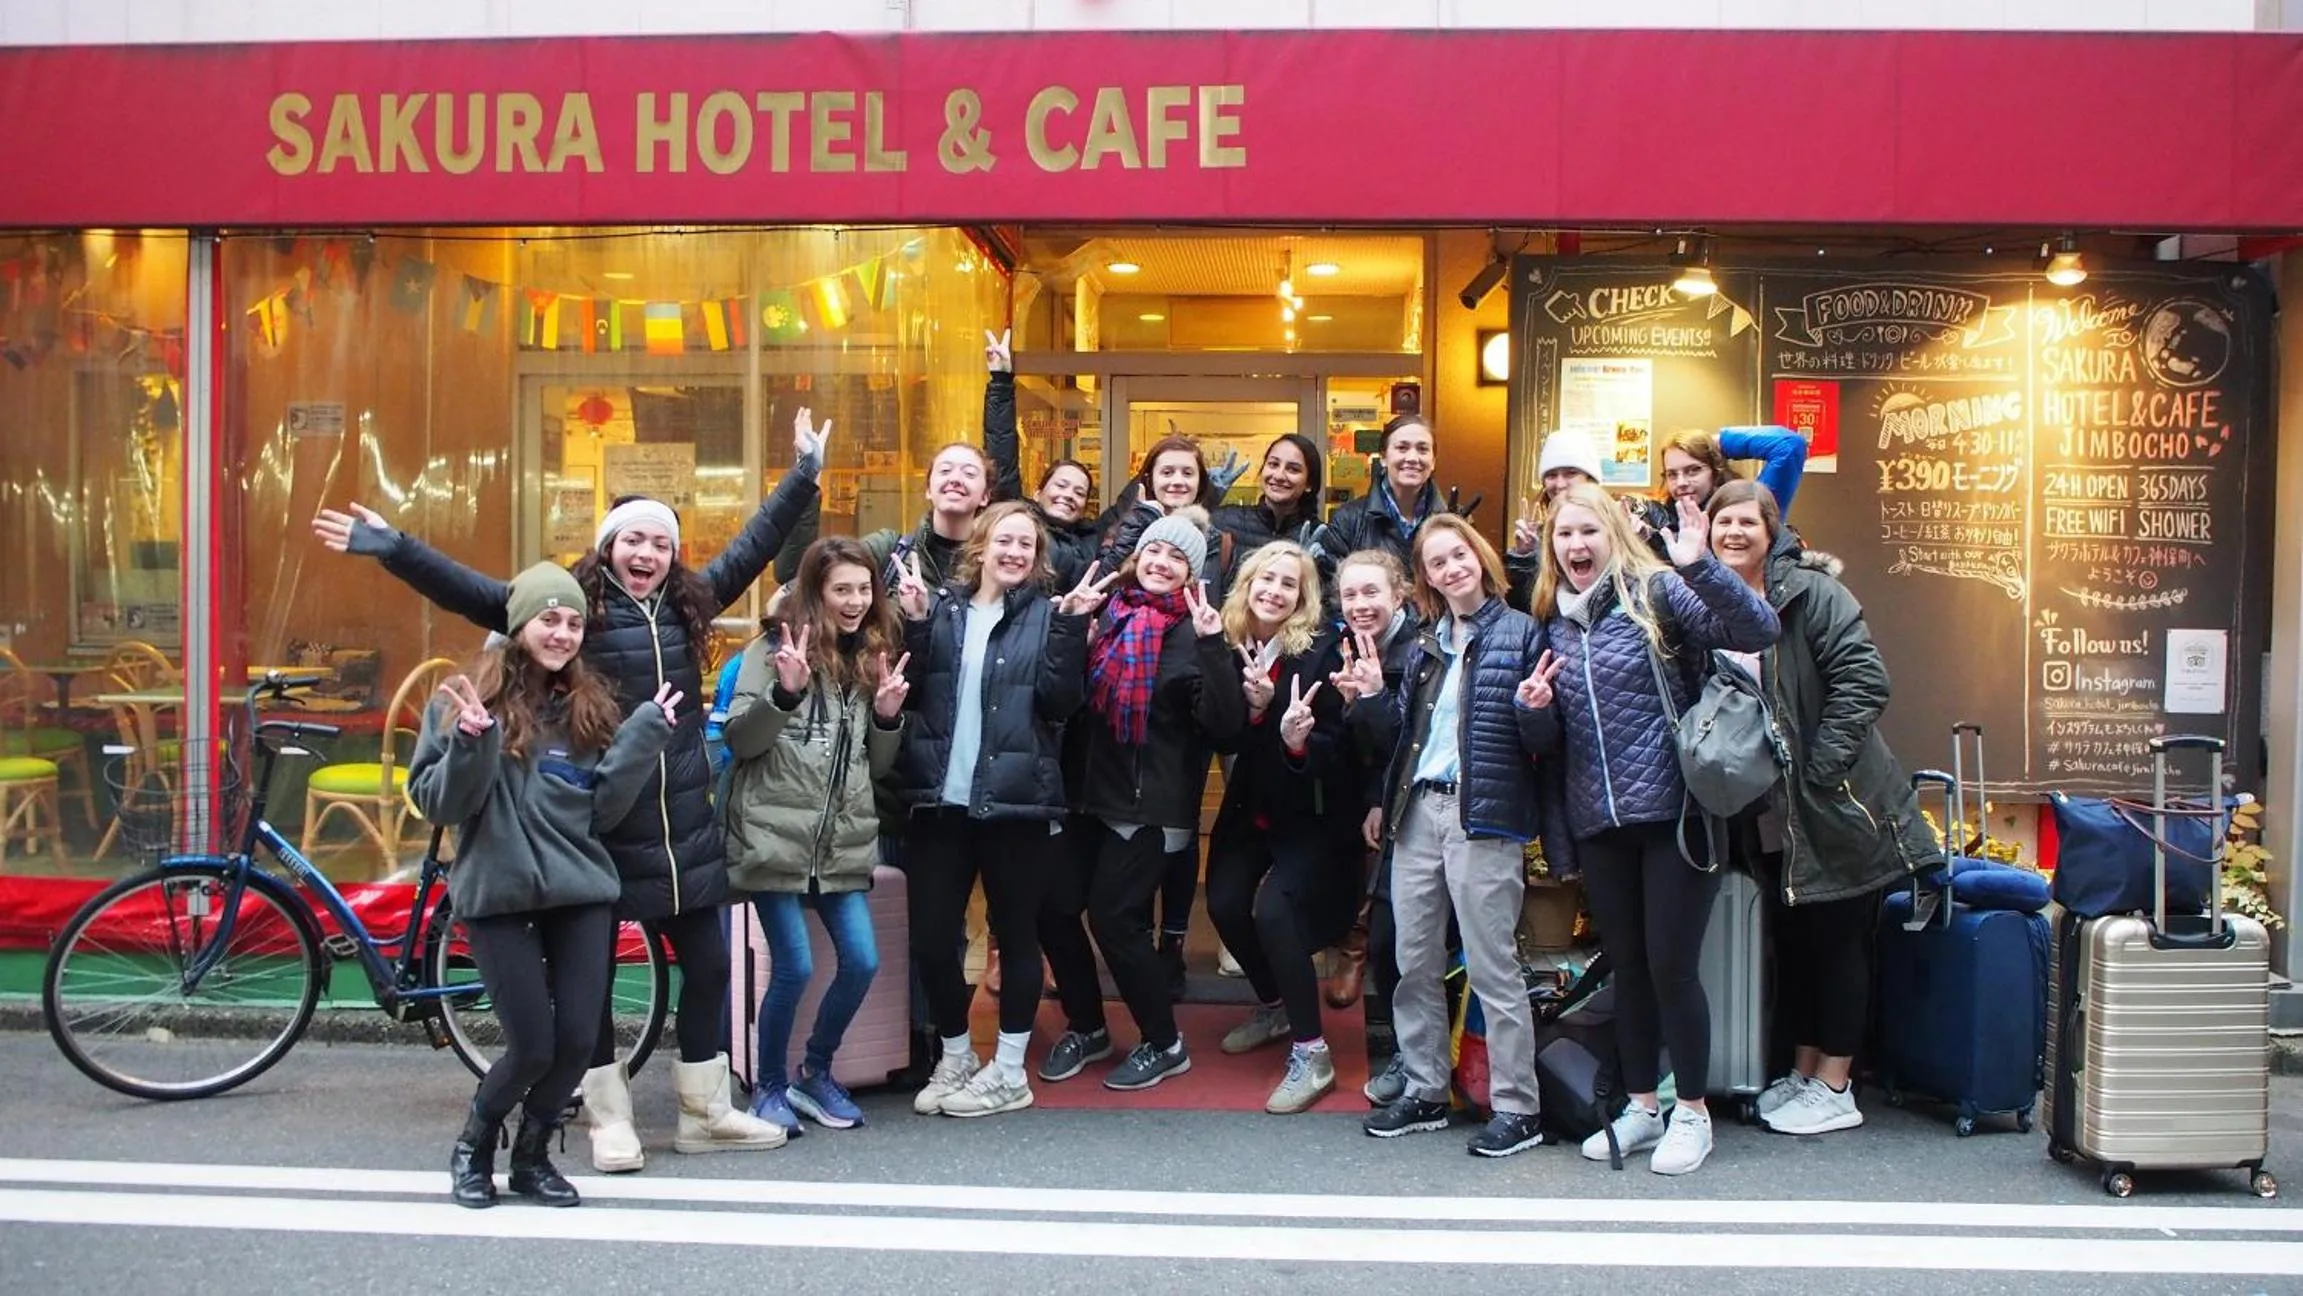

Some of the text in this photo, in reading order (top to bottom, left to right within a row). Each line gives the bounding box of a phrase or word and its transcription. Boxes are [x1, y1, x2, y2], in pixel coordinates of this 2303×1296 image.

[266, 85, 1246, 175] SAKURA HOTEL & CAFE
[1588, 284, 1677, 319] CHECK
[1815, 289, 1974, 324] FOOD&DRINK
[1571, 326, 1649, 346] UPCOMING
[2036, 294, 2145, 346] Welcome
[1778, 351, 1856, 370] 世界の料理
[2042, 347, 2136, 384] SAKURA
[1878, 390, 2022, 449] MORNING
[2043, 390, 2222, 428] HOTEL&CAFE
[2059, 426, 2189, 460] JIMBOCHO
[1876, 456, 2023, 493] ¥390 モーニング
[2043, 473, 2081, 499] 24H
[2086, 475, 2128, 499] OPEN
[1881, 500, 1915, 520] トースト
[2046, 506, 2212, 540] FREE WIFI SHOWER
[2087, 566, 2136, 586] ようこそ
[2040, 628, 2149, 656] Follow us!
[2075, 664, 2156, 697] Instagram
